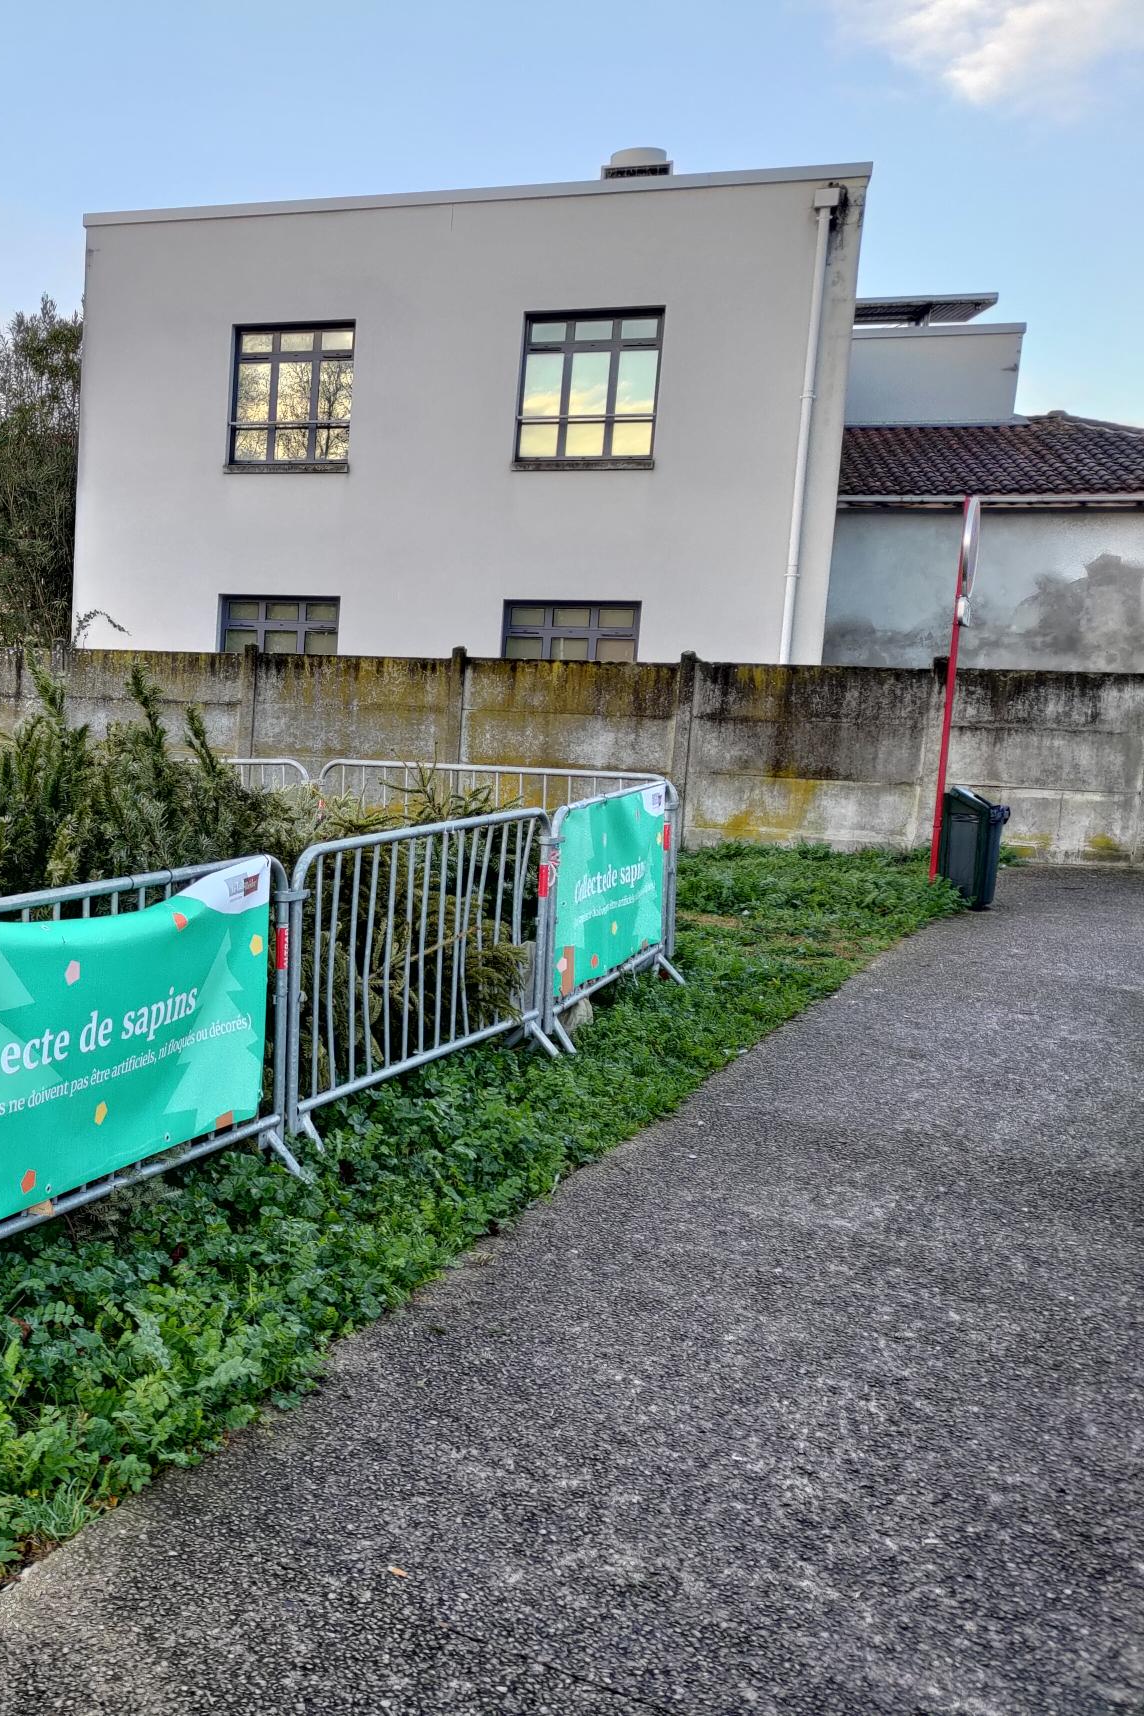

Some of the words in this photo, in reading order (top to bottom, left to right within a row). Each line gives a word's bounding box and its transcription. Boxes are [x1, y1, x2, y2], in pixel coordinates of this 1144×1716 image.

[79, 1010, 113, 1053] de
[121, 986, 198, 1041] sapins
[9, 1097, 26, 1114] ne
[27, 1081, 68, 1108] doivent
[69, 1075, 89, 1097] pas
[90, 1068, 111, 1085] être
[111, 1048, 157, 1079] artificiels,
[158, 1043, 166, 1060] ni
[167, 1028, 195, 1056] floqués
[196, 1028, 208, 1042] ou
[209, 1012, 252, 1038] décorés)
